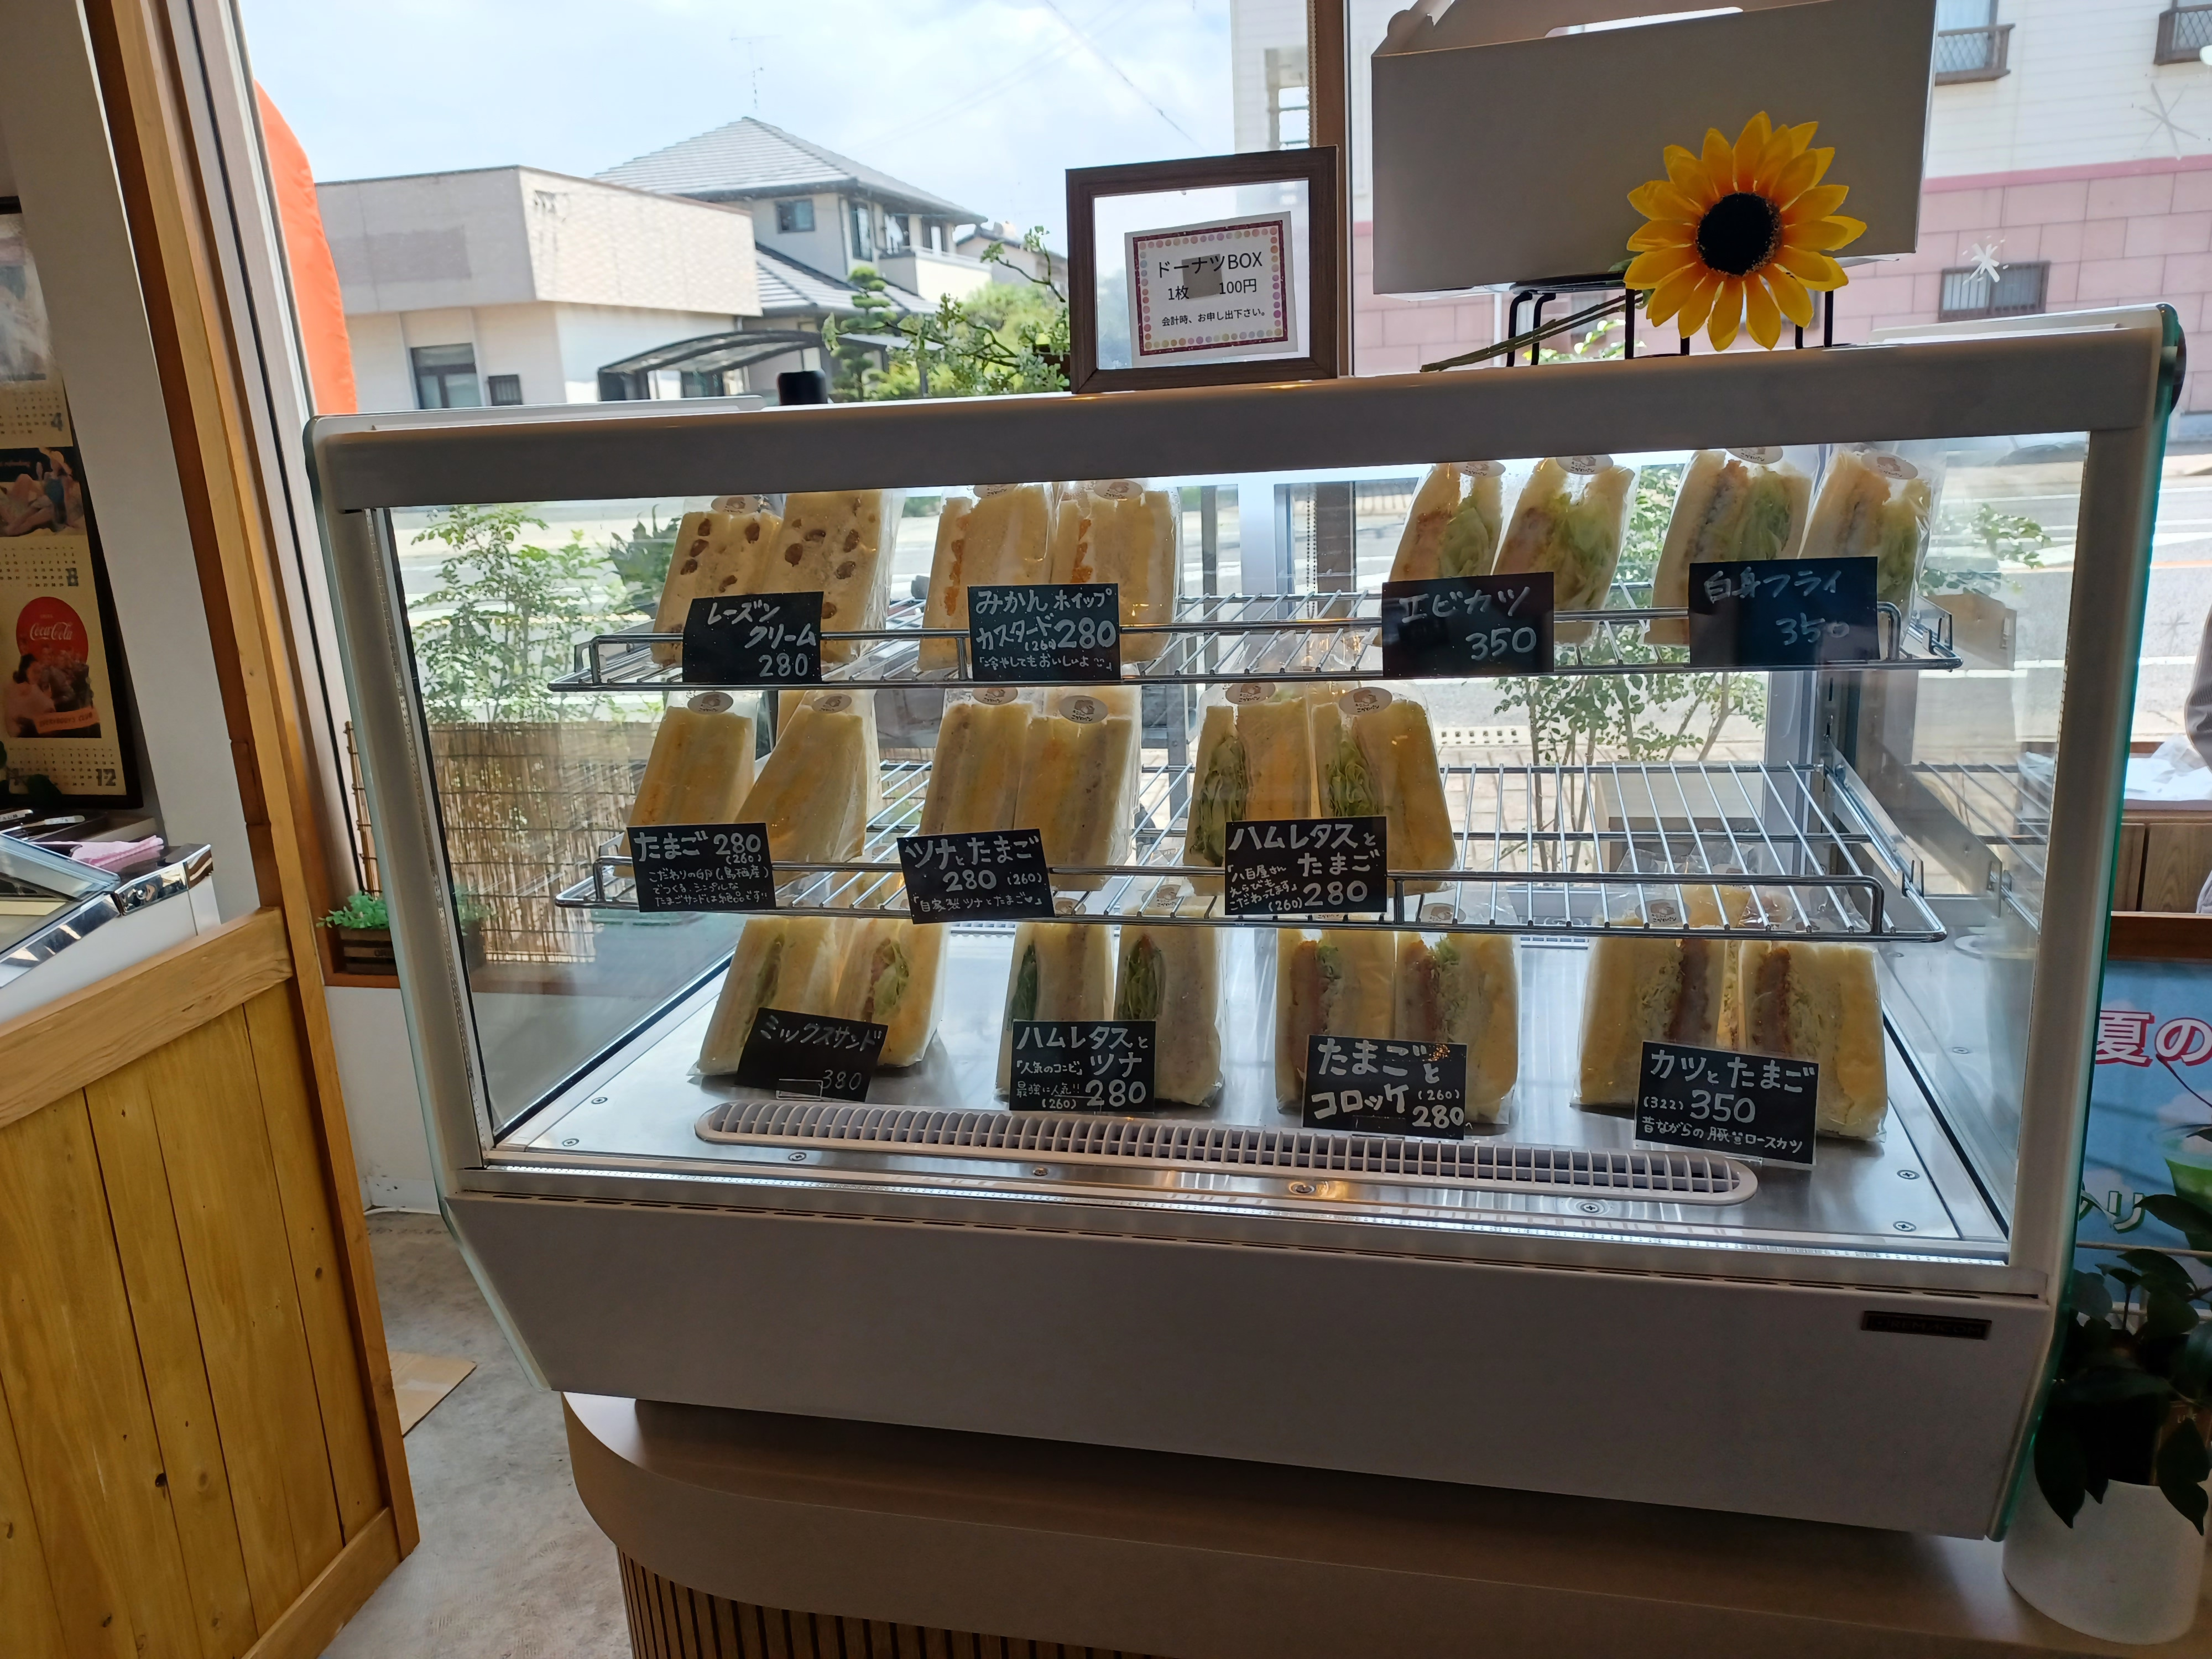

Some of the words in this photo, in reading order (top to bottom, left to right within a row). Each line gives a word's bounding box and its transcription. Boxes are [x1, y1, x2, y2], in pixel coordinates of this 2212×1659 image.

[1159, 252, 1262, 278] ドーナツBOX
[1168, 285, 1189, 301] 1枚
[1219, 279, 1256, 294] 100円
[1162, 309, 1265, 326] 会計時、お申し出下さい。
[1704, 566, 1841, 604] 白身フライ
[707, 599, 780, 624] レーズン
[976, 589, 1048, 614] みかん
[1053, 588, 1112, 611] ホイップ
[1399, 586, 1530, 623] エビカツ
[744, 623, 816, 649] クリーム
[976, 613, 1054, 650] カスタード
[1054, 617, 1116, 649] 280
[1776, 612, 1850, 646] 350
[1465, 627, 1536, 660] 350
[759, 653, 807, 677] 280
[95, 768, 116, 786] 12
[634, 831, 708, 862] たまご
[713, 833, 761, 854] 280
[1228, 824, 1376, 851] ハムレタスと
[726, 854, 761, 864] (260)
[905, 835, 1039, 870] ツナとたまご
[1297, 849, 1380, 877] たまご
[943, 869, 997, 892] 280
[1007, 872, 1042, 885] (260)
[1269, 897, 1302, 912] (260)
[1303, 880, 1368, 906] 280
[760, 1015, 883, 1051] ミックスサンド
[1016, 1026, 1148, 1050] ハムレタスと
[2095, 1010, 2212, 1067] 夏の
[1016, 1060, 1082, 1076] 「人気のコンビ」
[1091, 1052, 1141, 1077] ツナ
[1318, 1038, 1440, 1084] たまごと
[1650, 1049, 1815, 1093] カツとたまご
[818, 1070, 862, 1091] 380
[1085, 1079, 1146, 1107] 280
[1042, 1099, 1076, 1109] (260)
[1311, 1083, 1409, 1120] コロッケ
[1418, 1089, 1460, 1100] (260)
[1643, 1096, 1683, 1110] (322)
[1690, 1089, 1755, 1123] 350
[1412, 1105, 1464, 1129] 280
